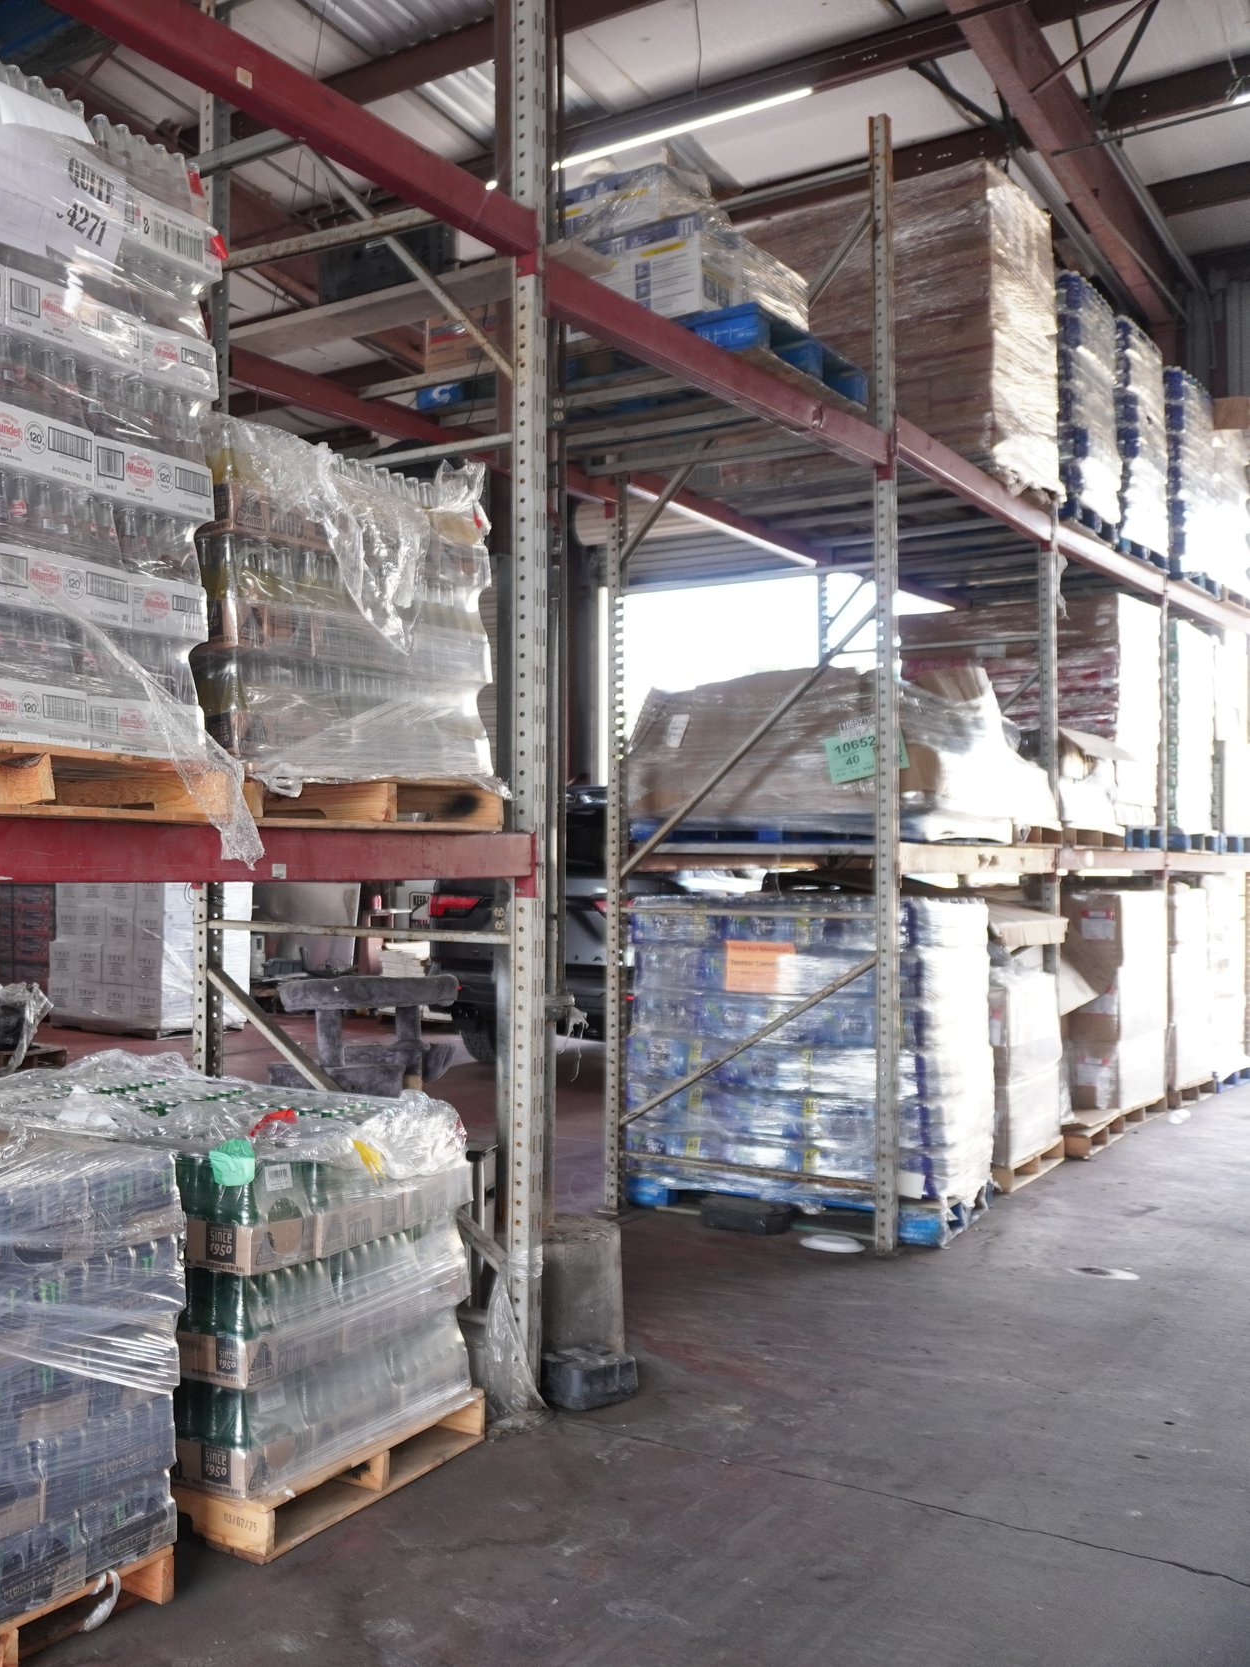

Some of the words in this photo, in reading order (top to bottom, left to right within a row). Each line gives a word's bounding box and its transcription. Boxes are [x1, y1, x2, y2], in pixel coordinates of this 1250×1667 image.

[29, 433, 42, 444] 120
[125, 461, 155, 479] Mundet
[159, 472, 170, 483] 120
[29, 568, 62, 587] Mundet
[67, 577, 81, 589] 120
[24, 702, 37, 713] 120
[834, 736, 876, 755] 10652
[845, 754, 861, 766] 40
[209, 1230, 232, 1245] SINCE
[209, 1243, 233, 1257] 1950
[218, 1350, 237, 1361] SINCE
[218, 1358, 237, 1369] 1950
[205, 1452, 227, 1465] SINCE
[205, 1462, 227, 1478] 1950
